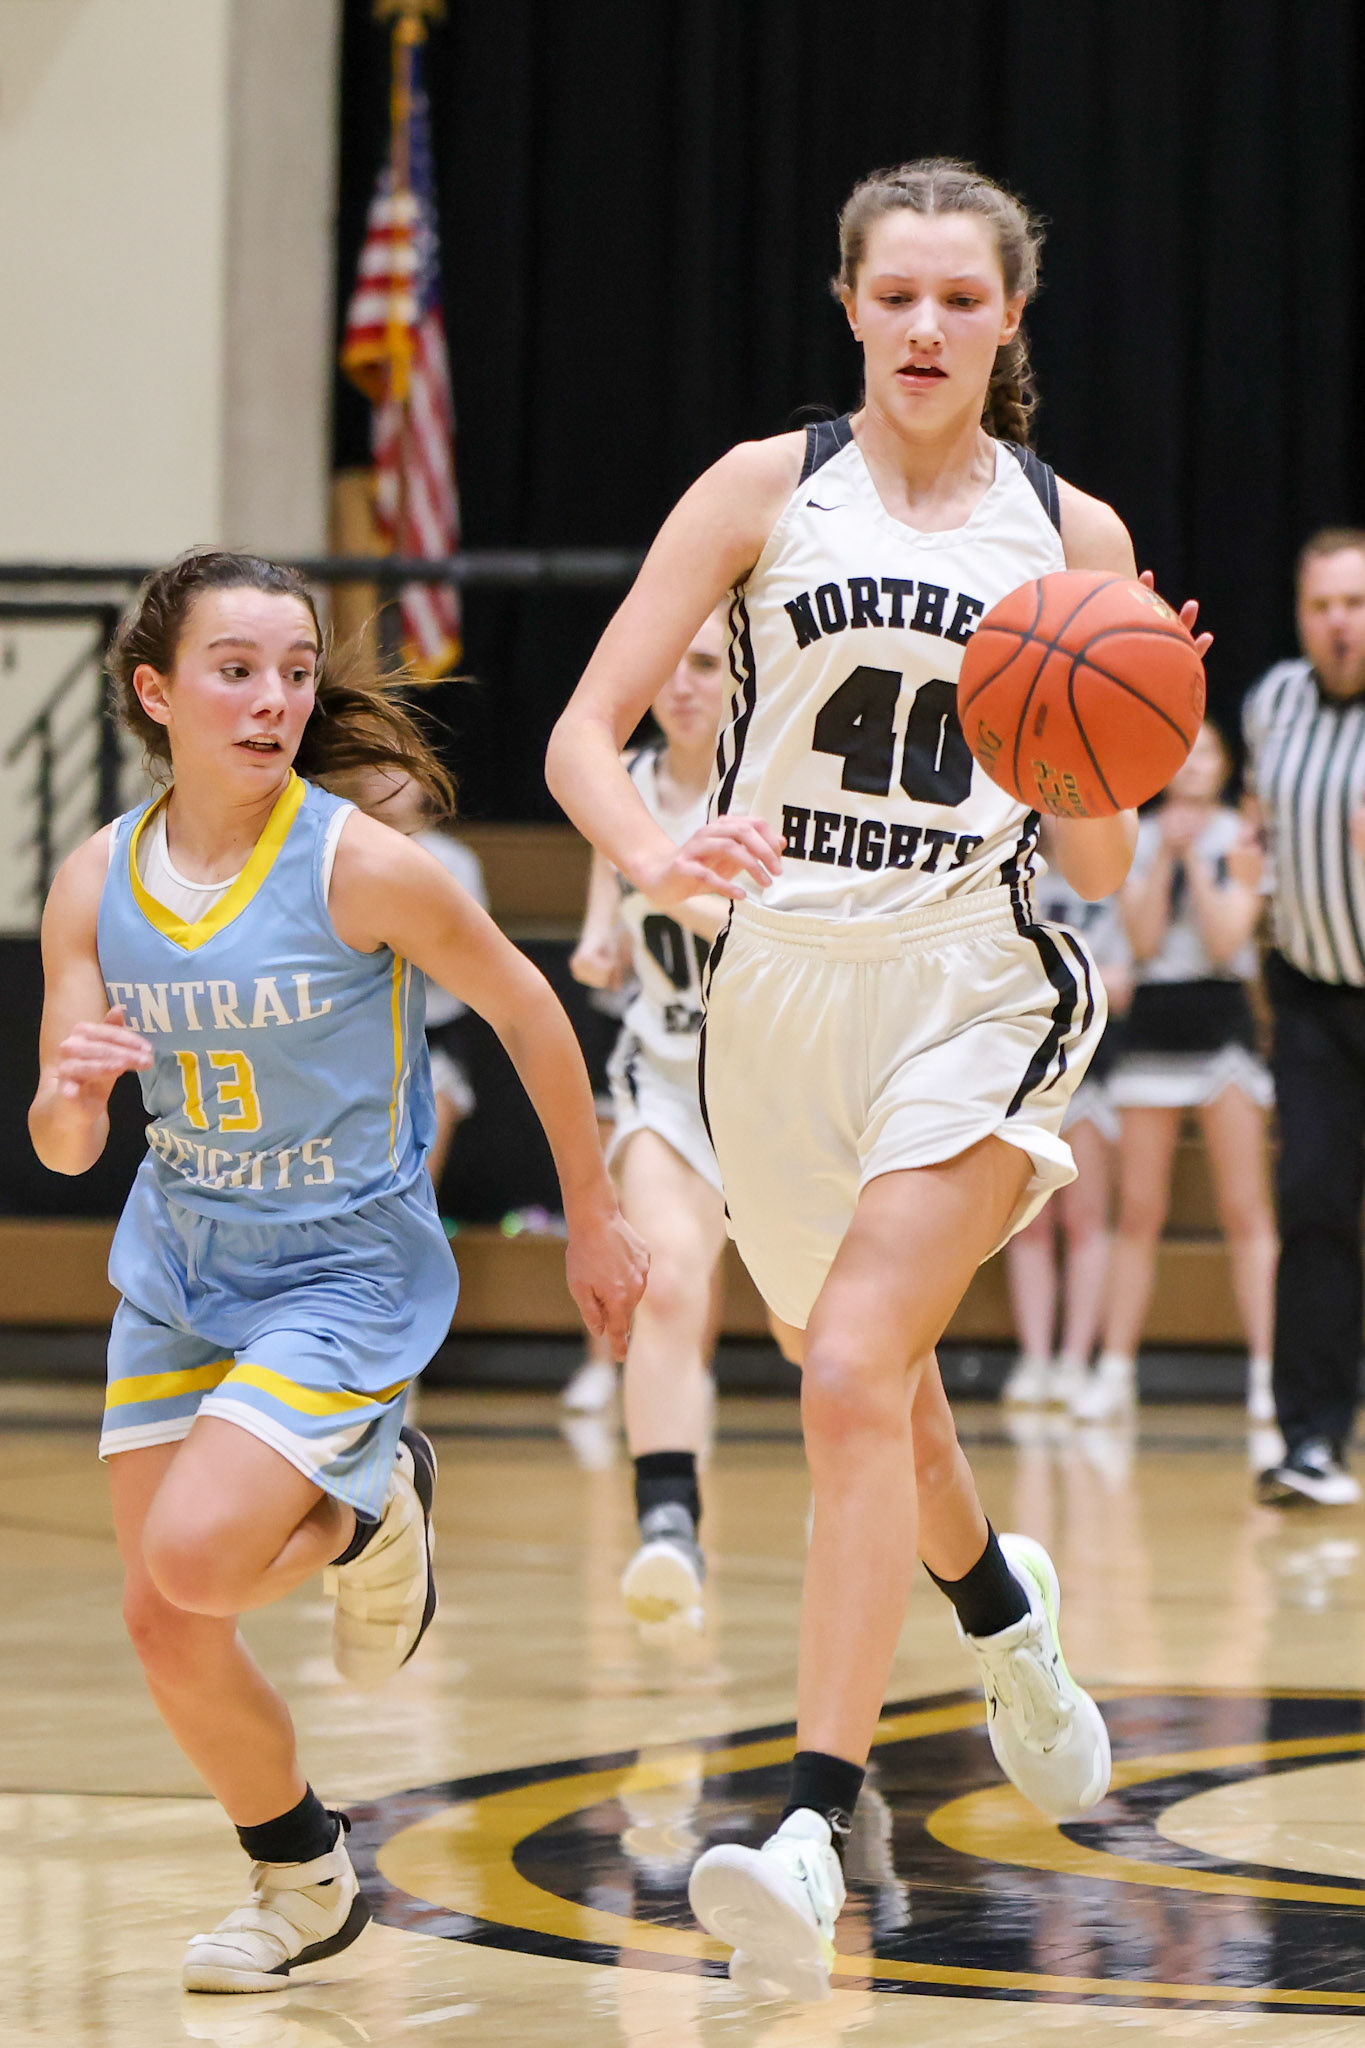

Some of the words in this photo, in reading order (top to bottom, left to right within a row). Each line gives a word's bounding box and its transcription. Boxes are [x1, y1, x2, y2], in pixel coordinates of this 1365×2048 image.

[784, 577, 984, 649] NORTHE
[812, 665, 973, 807] 40
[782, 805, 984, 873] HEIGHTS
[106, 973, 332, 1033] ENTRAL
[173, 1050, 262, 1133] 13
